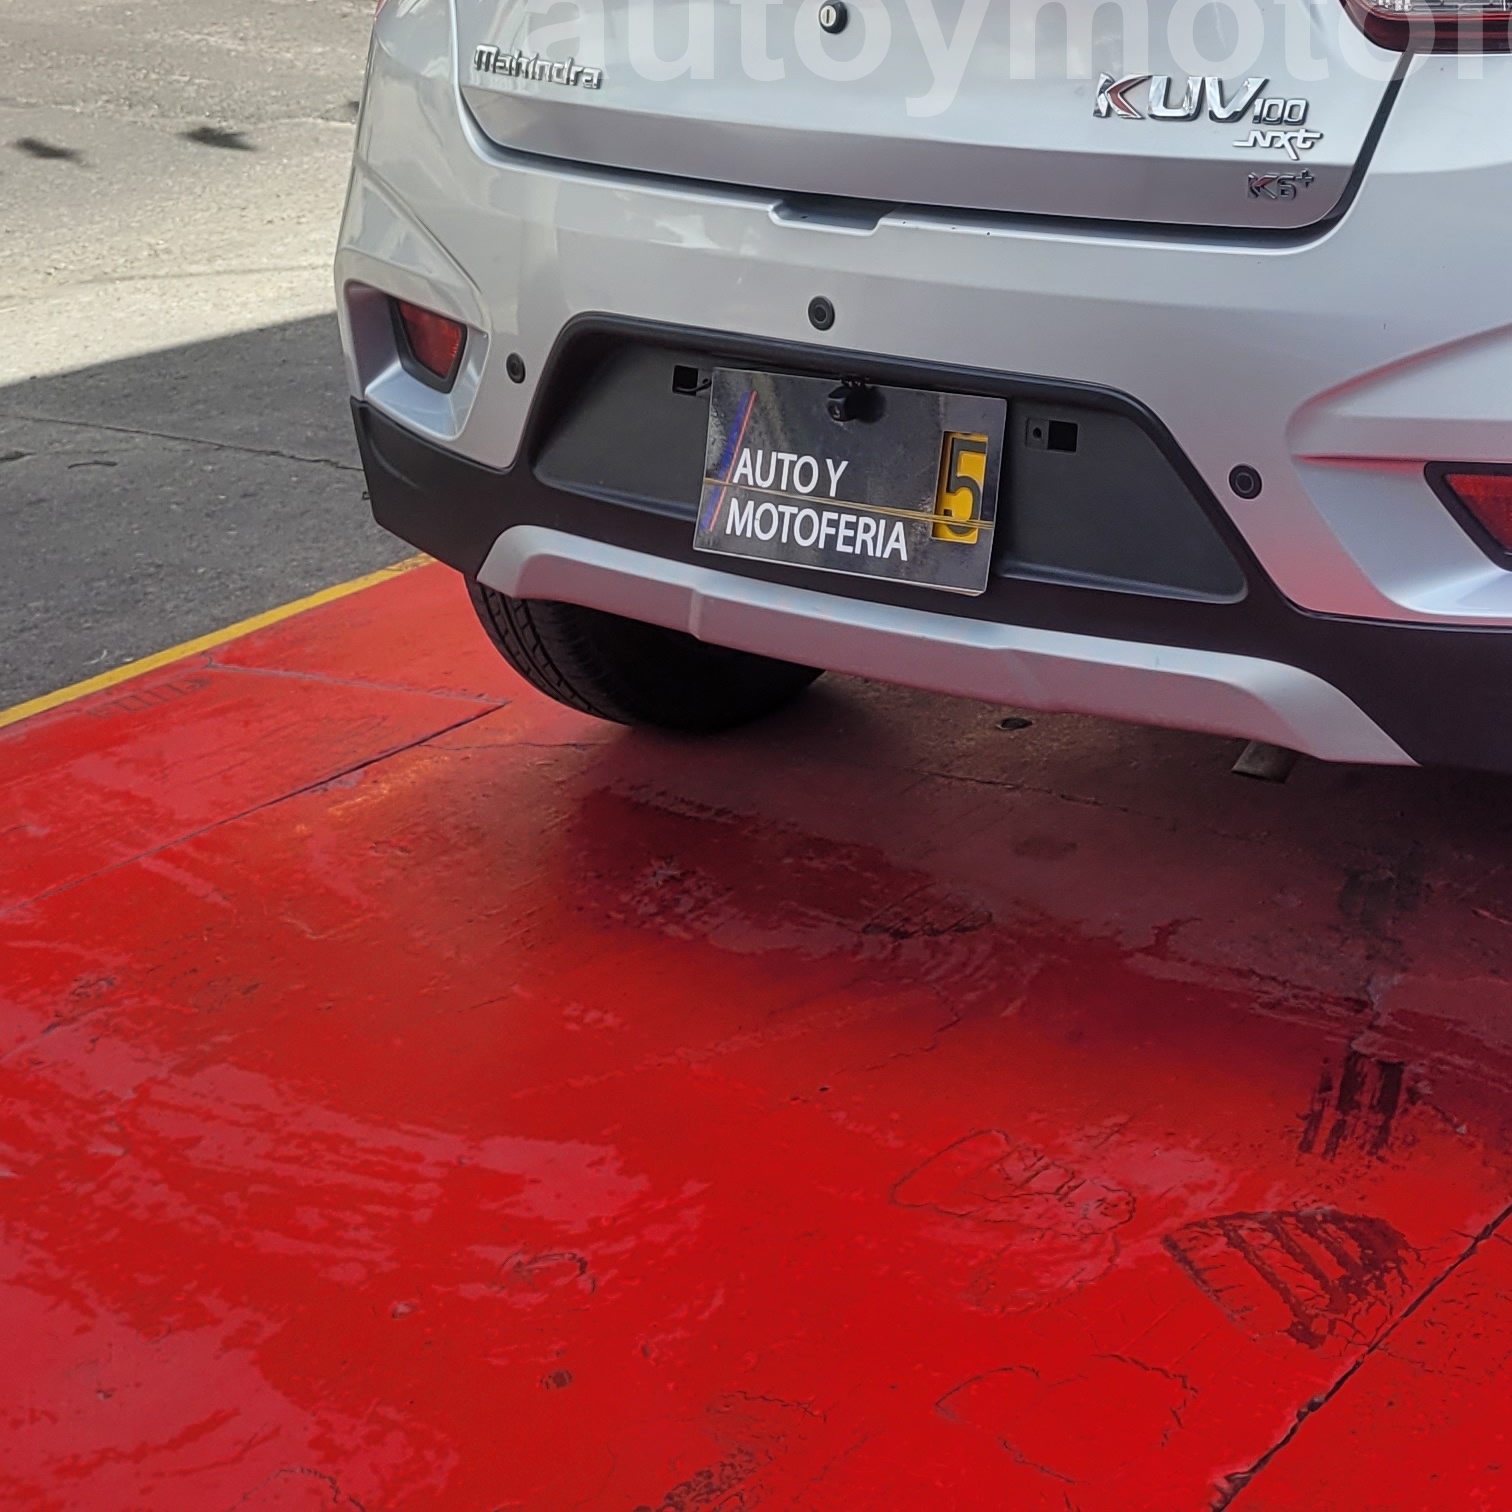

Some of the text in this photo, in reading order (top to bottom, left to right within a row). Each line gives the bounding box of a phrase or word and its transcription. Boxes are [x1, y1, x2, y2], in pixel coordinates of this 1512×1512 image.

[733, 448, 849, 497] AUTO Y
[943, 436, 988, 538] 5
[725, 498, 908, 561] MOTOFERIA
